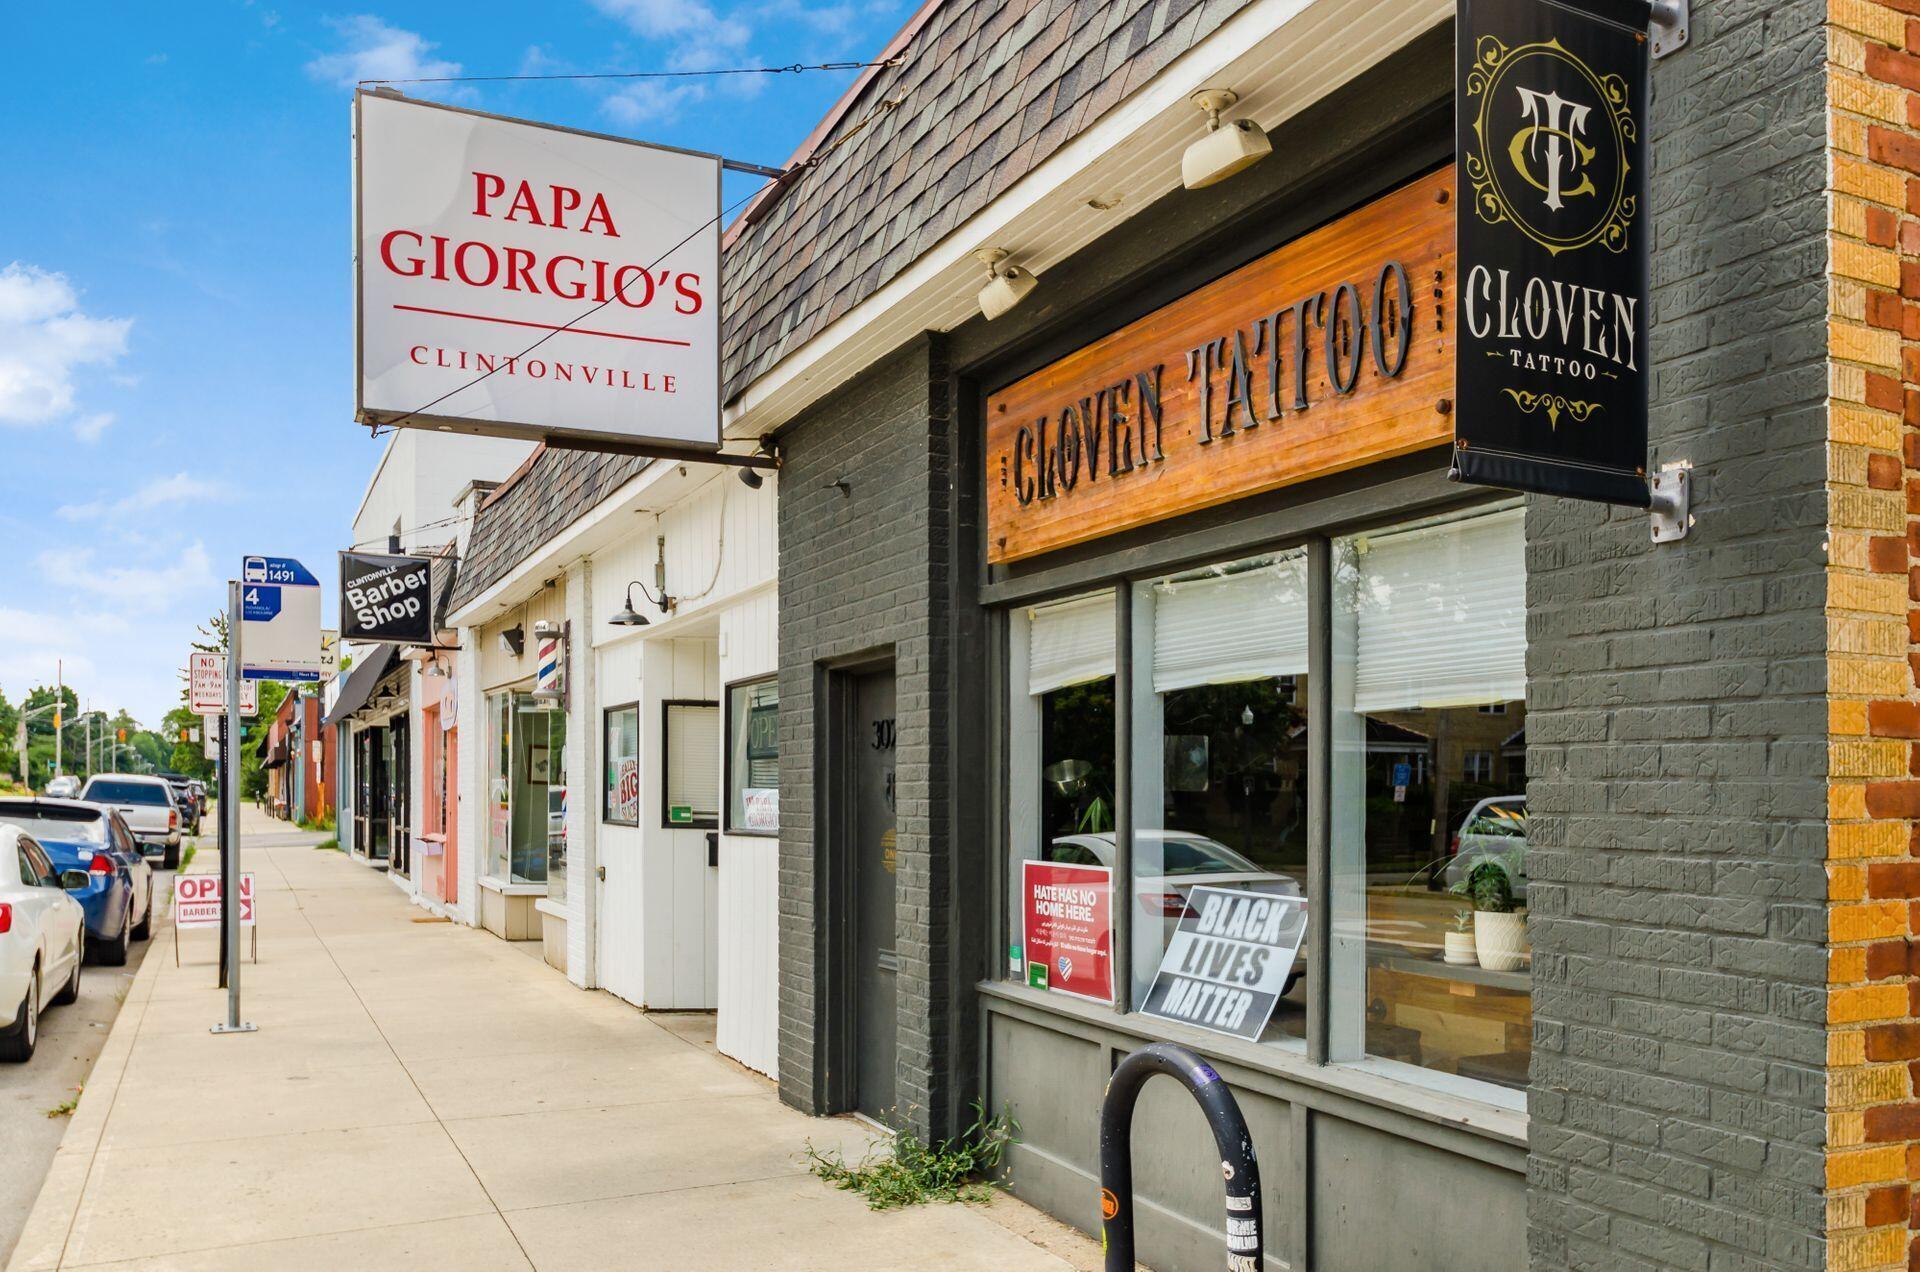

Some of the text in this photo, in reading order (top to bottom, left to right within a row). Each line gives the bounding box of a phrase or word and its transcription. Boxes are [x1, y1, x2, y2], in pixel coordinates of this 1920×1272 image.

[472, 171, 620, 238] PAPA
[380, 230, 702, 315] GIORGIO'S
[1464, 264, 1638, 373] CLOVEN
[410, 345, 677, 393] CLINTONVILLE
[1510, 349, 1597, 381] TATTOO
[1014, 260, 1414, 507] CLOVEN TATTOO
[269, 570, 294, 582] 1491
[346, 568, 427, 611] Barber
[347, 564, 398, 588] CLINTONVILLE
[245, 588, 259, 605] 4
[357, 596, 420, 630] Shop
[194, 669, 223, 680] STOPPING
[201, 658, 215, 668] NO
[751, 716, 778, 748] OPE
[183, 907, 217, 916] BARBER
[1034, 884, 1097, 907] HATE HAS NO
[1036, 899, 1095, 923] HOME HERE.
[1196, 893, 1290, 945] BLACK
[1180, 937, 1271, 986] LIVES
[1160, 976, 1253, 1031] MATTER
